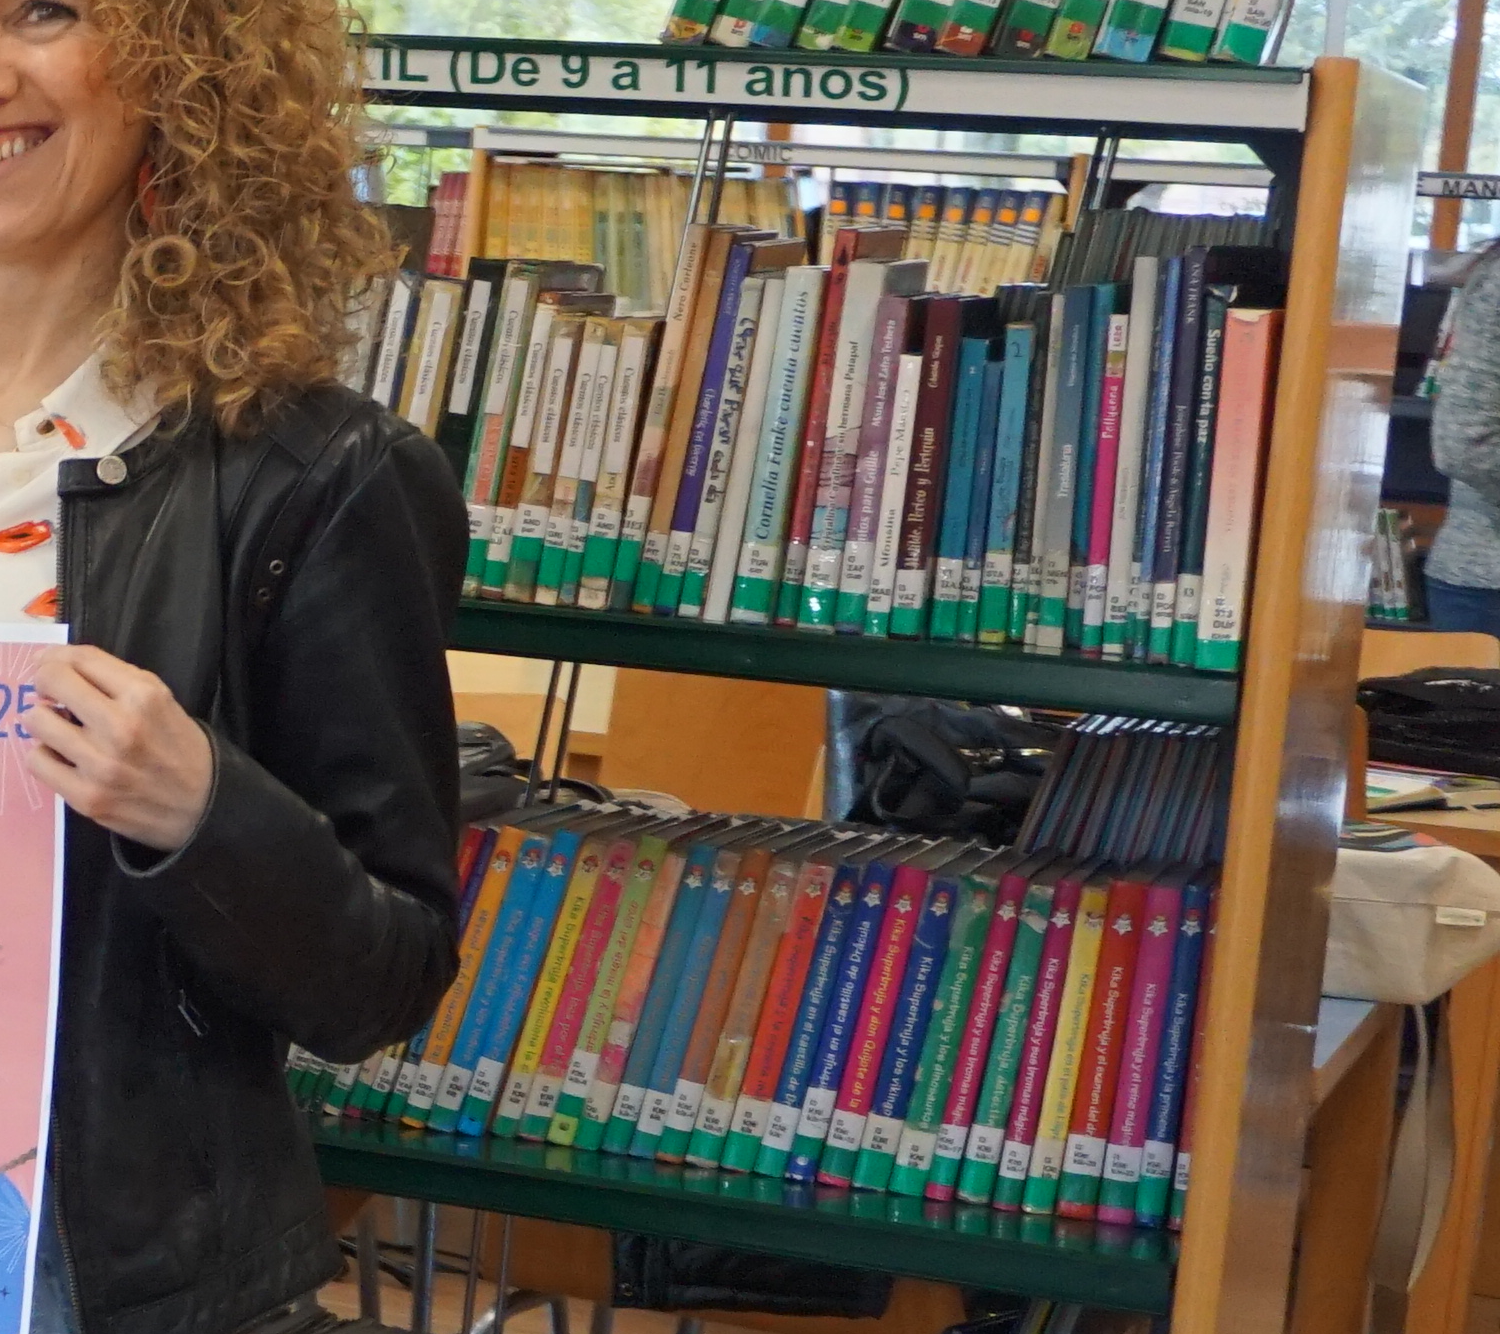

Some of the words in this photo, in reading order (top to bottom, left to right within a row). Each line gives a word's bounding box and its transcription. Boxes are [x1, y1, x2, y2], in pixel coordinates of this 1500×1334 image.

[787, 290, 810, 354] cuentos
[1204, 328, 1222, 371] Sueño
[778, 357, 799, 412] cuenta
[769, 415, 790, 468] Funke
[754, 470, 782, 540] Cornelia
